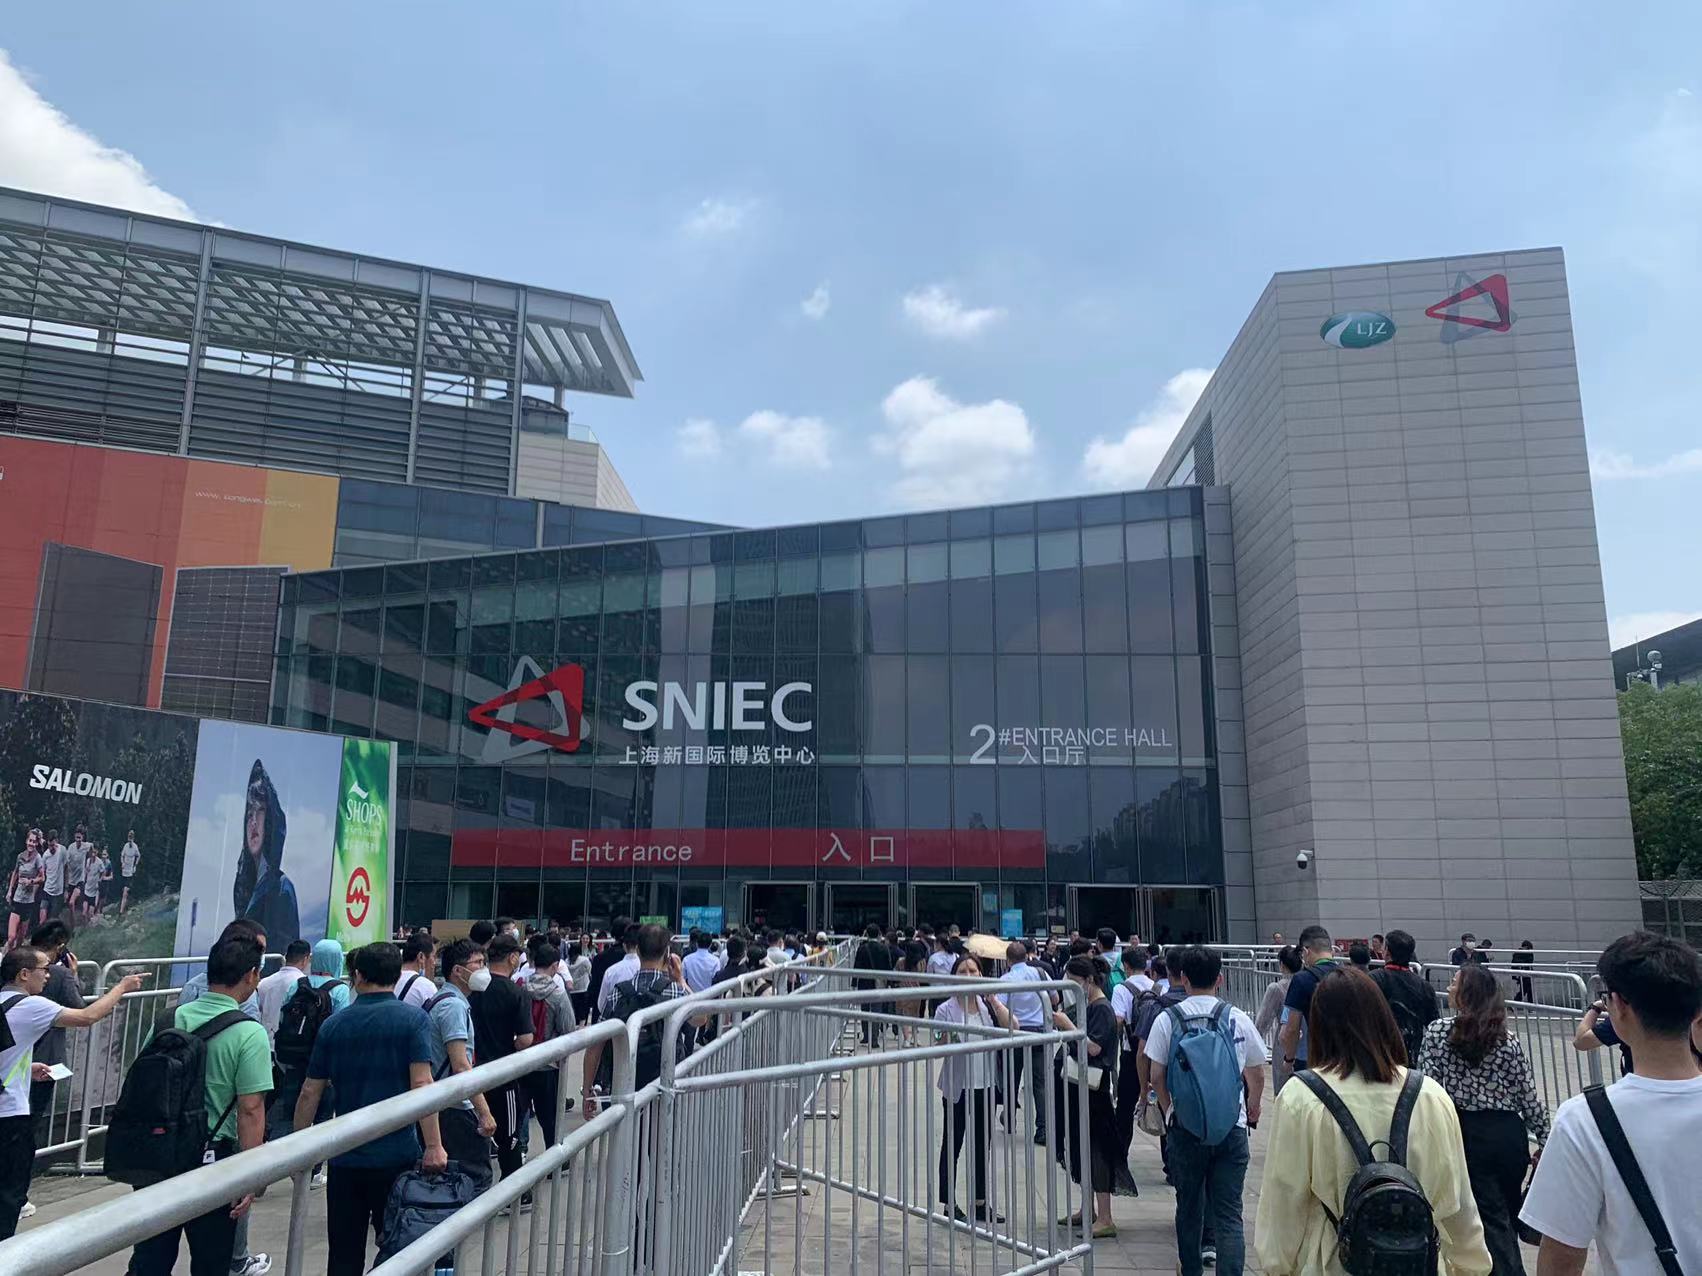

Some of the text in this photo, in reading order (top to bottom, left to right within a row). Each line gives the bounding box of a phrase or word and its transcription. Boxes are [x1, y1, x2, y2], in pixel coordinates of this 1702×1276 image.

[1357, 321, 1387, 337] LJZ
[622, 680, 813, 733] SNIEC
[1124, 728, 1173, 747] HALL
[618, 744, 815, 766] 上海新国际博览中心
[1018, 745, 1086, 766] 入口厅
[29, 763, 143, 805] SALOMON
[346, 798, 382, 826] SHOPS
[570, 839, 693, 862] Entrance
[822, 832, 895, 863] 入口
